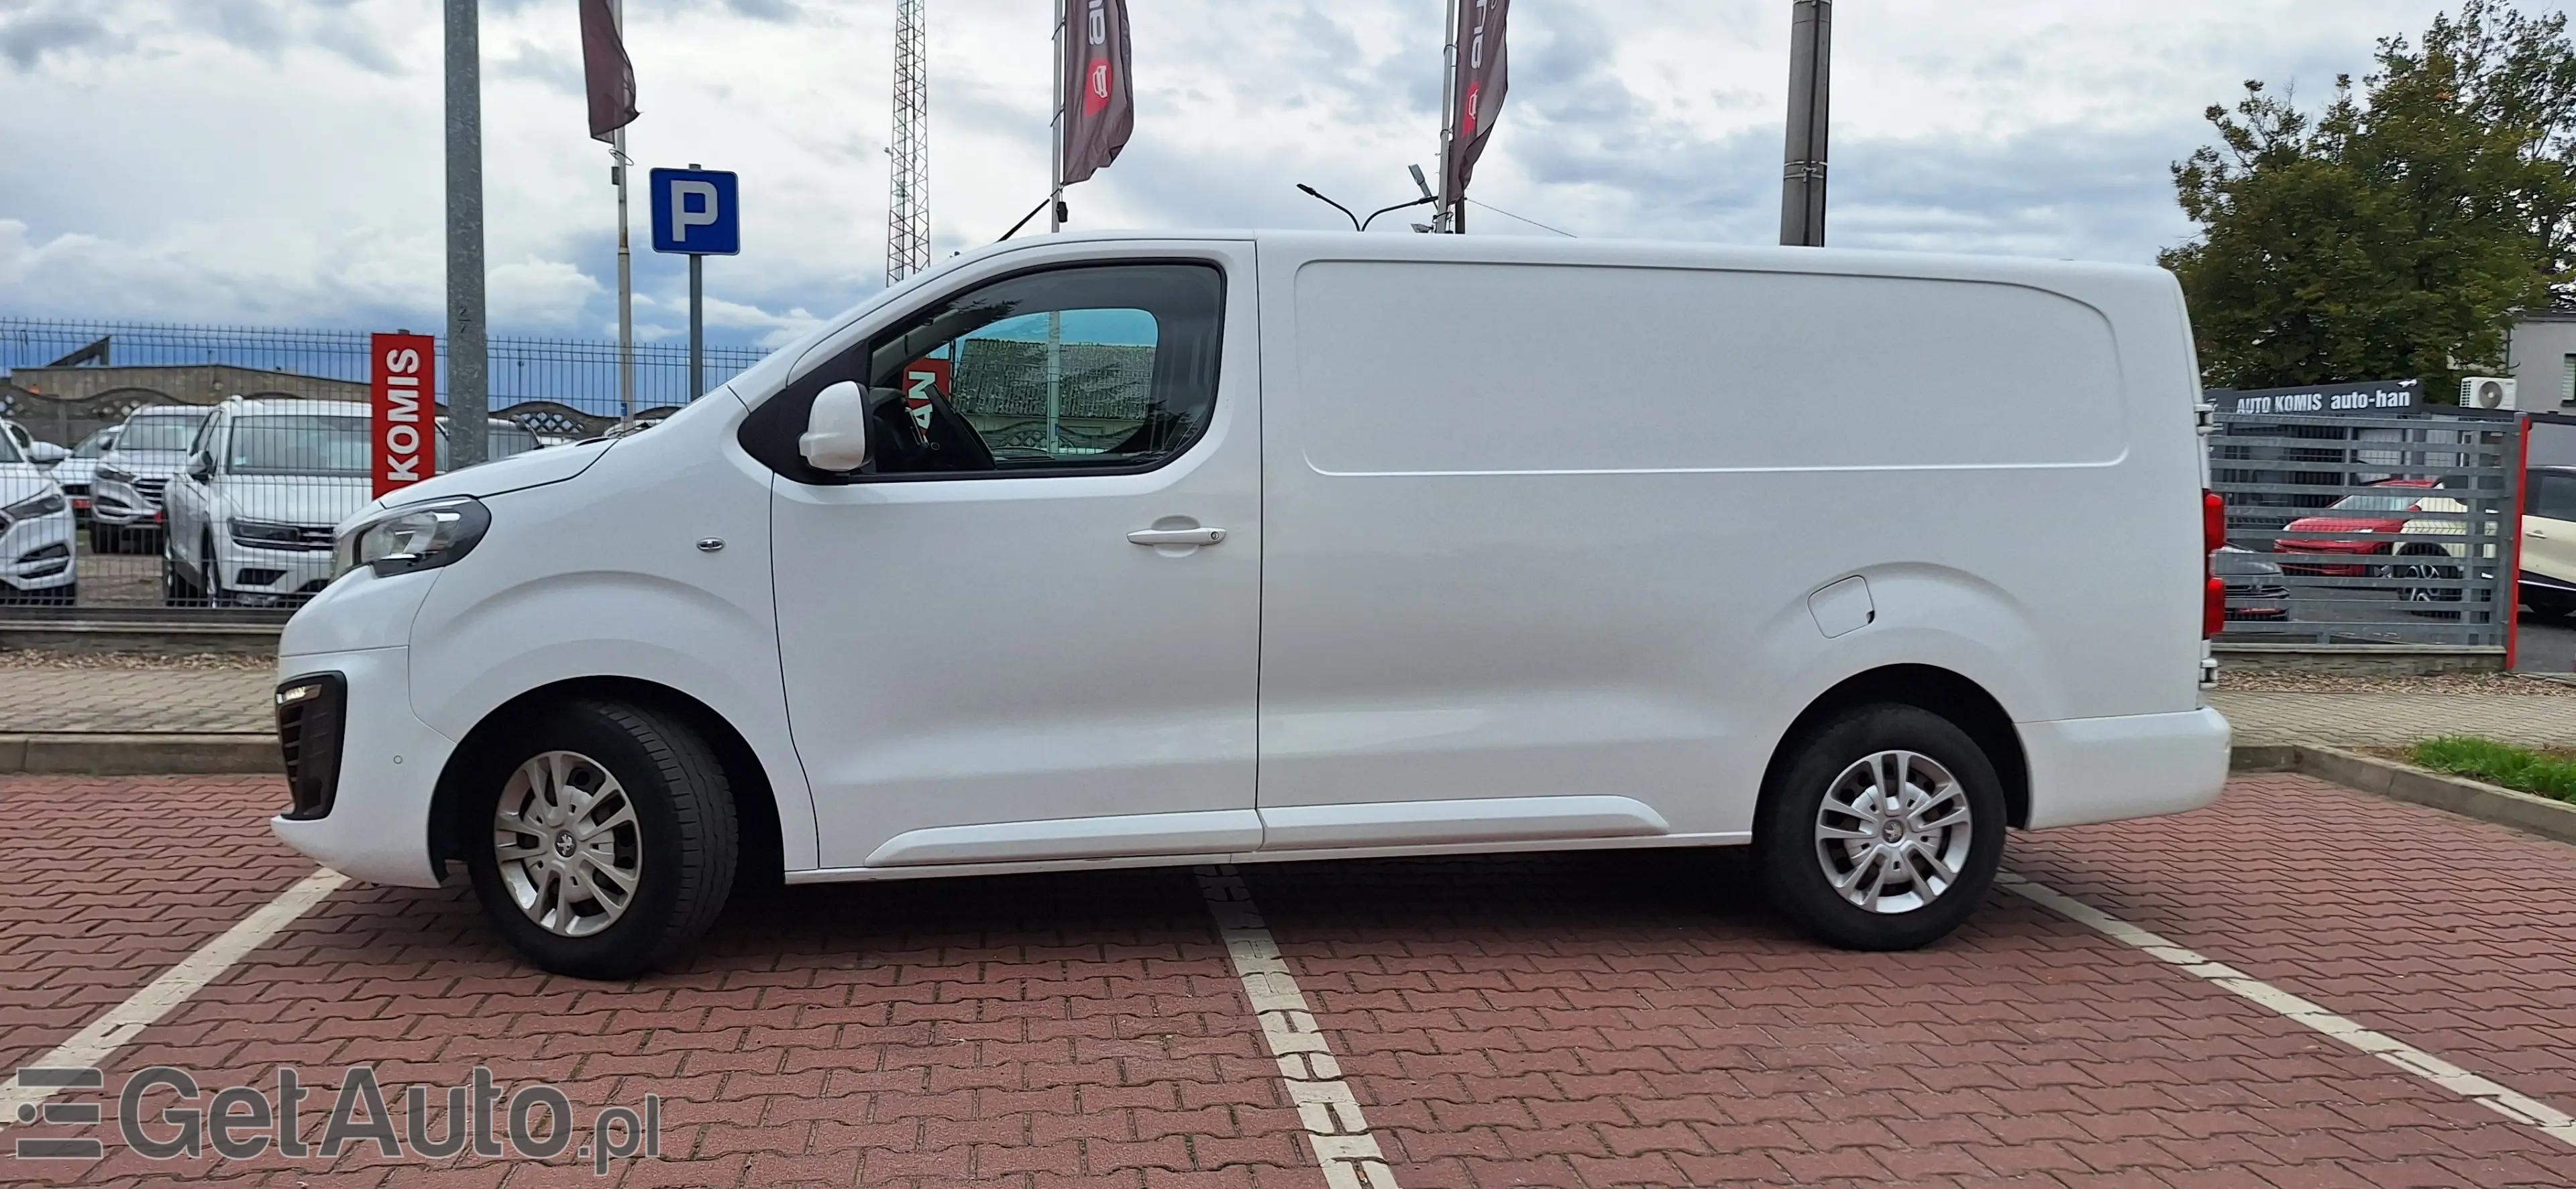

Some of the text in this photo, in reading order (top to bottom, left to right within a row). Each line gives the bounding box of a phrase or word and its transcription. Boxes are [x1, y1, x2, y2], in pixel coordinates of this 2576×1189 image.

[671, 180, 718, 241] P
[386, 348, 420, 482] KOMIS
[908, 371, 936, 443] AN
[2236, 396, 2271, 414] AUTO
[2275, 393, 2322, 412] KOMIS
[2330, 389, 2410, 410] auto-han
